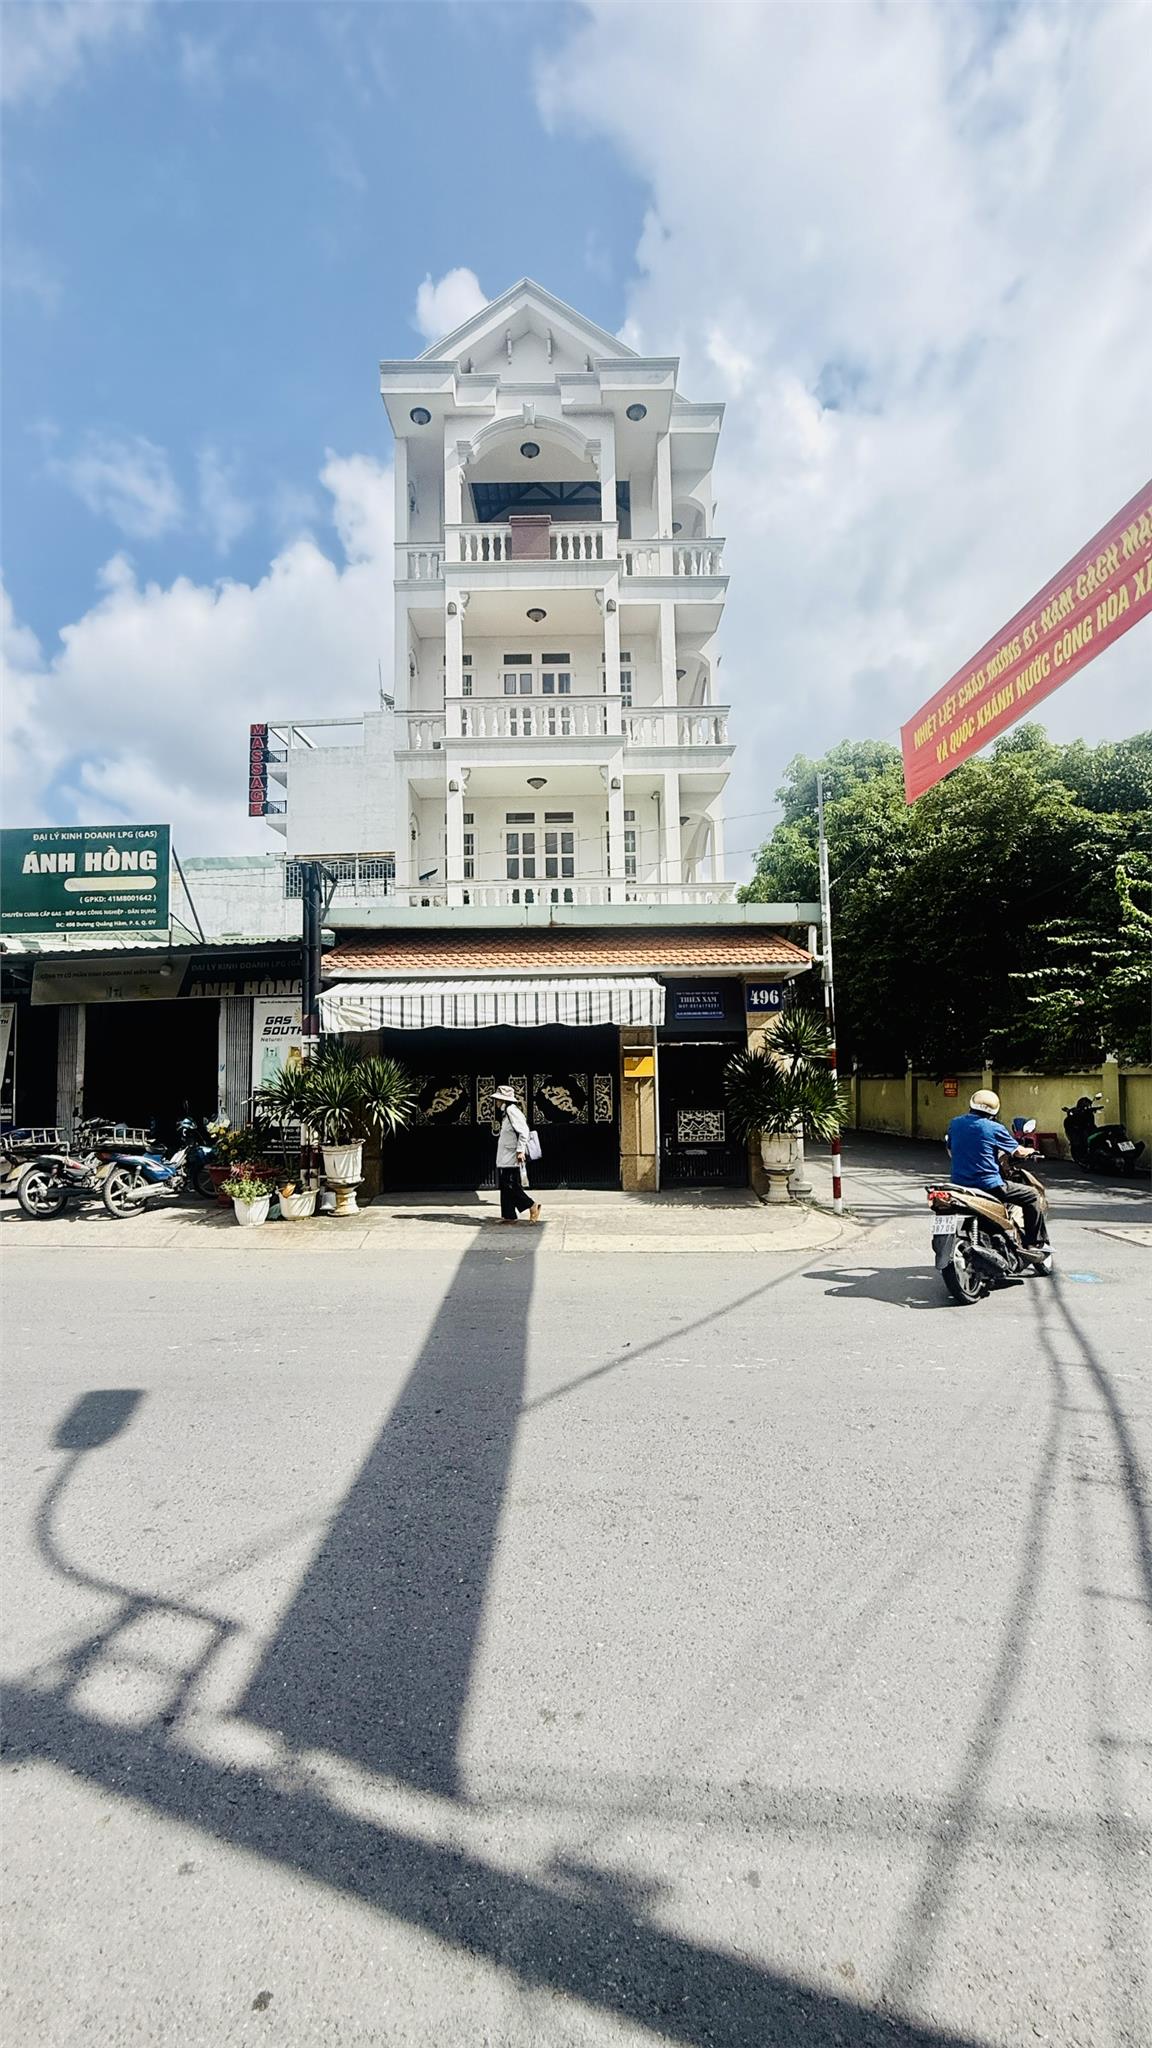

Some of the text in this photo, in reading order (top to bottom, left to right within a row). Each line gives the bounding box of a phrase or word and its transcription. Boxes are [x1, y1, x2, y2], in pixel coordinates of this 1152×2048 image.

[914, 713, 936, 750] NHIỆT
[938, 695, 956, 726] LIỆT
[958, 673, 985, 709] CHÀO
[986, 636, 1021, 684] MỪNG
[1040, 592, 1075, 634] NĂM
[1076, 561, 1120, 600] CÁCH
[1119, 507, 1152, 560] MẠ
[936, 736, 949, 764] VÀ
[950, 714, 975, 753] QUỐC
[976, 682, 1014, 732] KHÁNH
[1016, 650, 1051, 699] NƯỚC
[1053, 615, 1093, 667] CỘNG
[1096, 584, 1130, 632] HÒA
[248, 724, 266, 816] MASSAGE
[33, 833, 48, 843] ĐẠI
[49, 832, 60, 841] LÝ
[61, 832, 82, 840] KINH
[135, 830, 158, 839] (GAS)
[22, 845, 157, 874] ÁNH HỒNG
[751, 989, 779, 1005] 496
[265, 1016, 292, 1025] GAS
